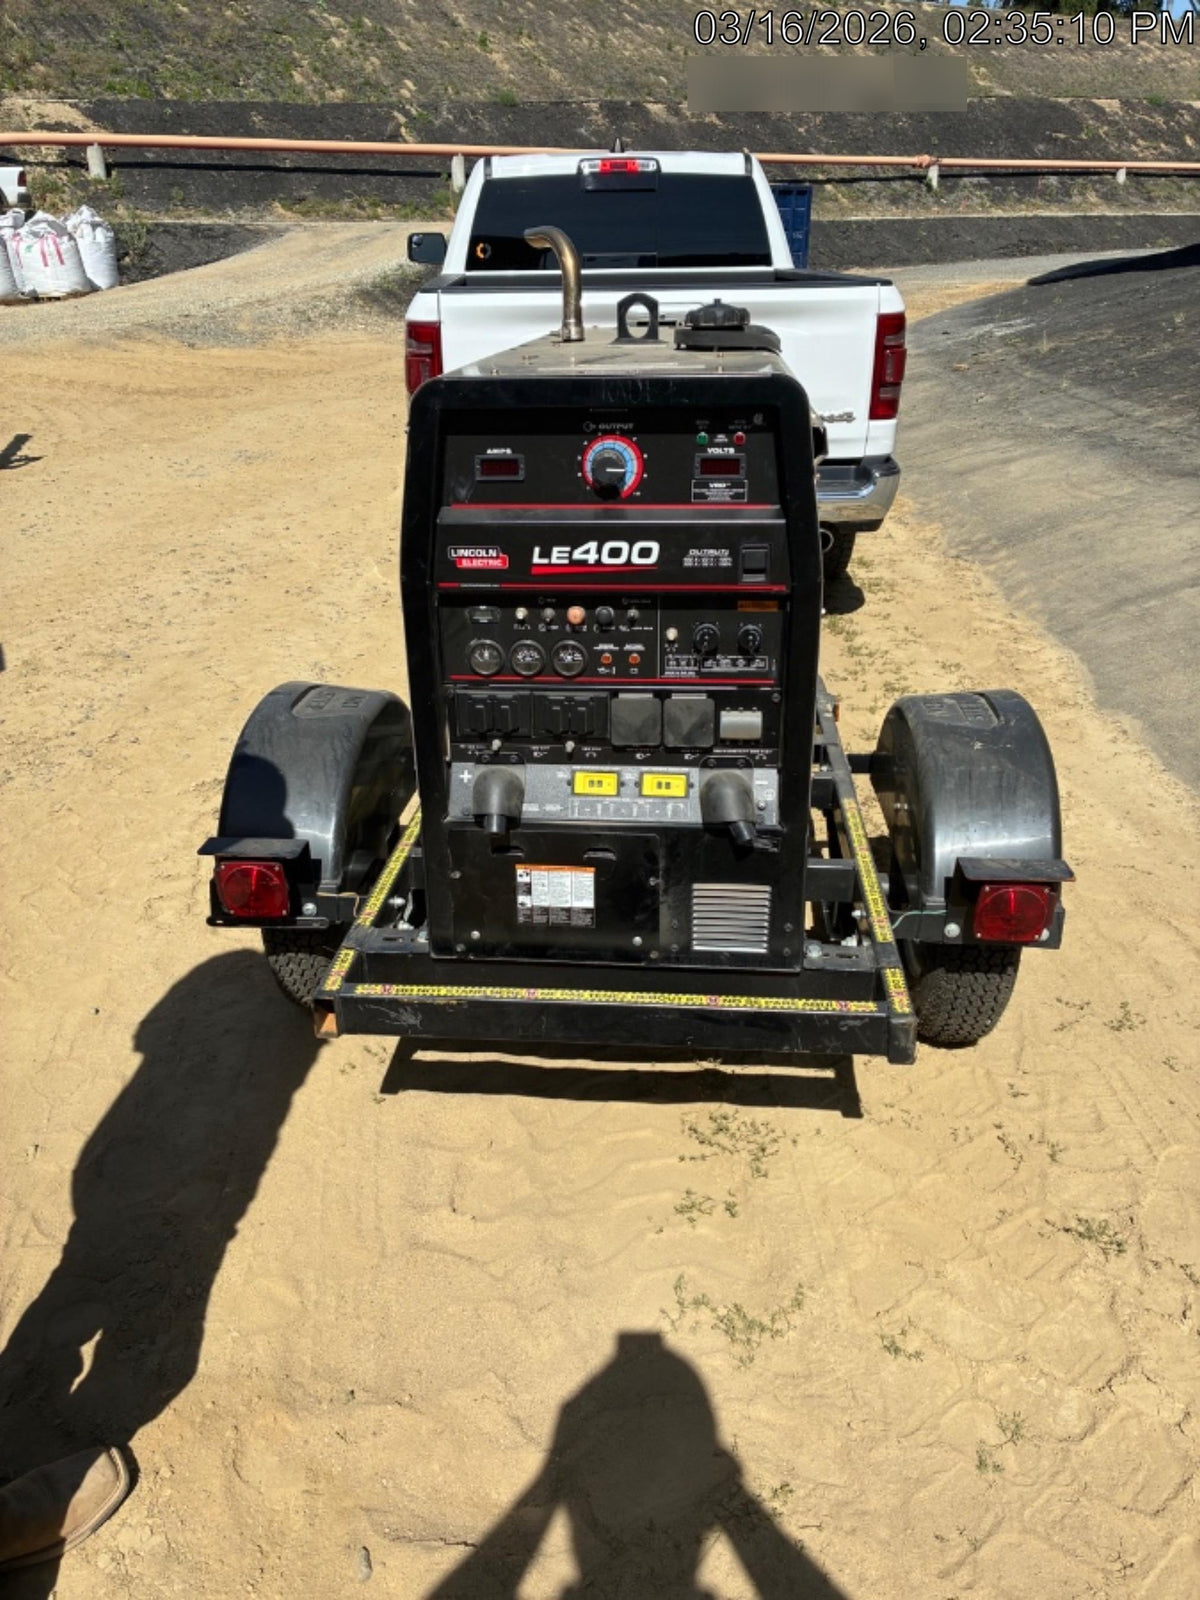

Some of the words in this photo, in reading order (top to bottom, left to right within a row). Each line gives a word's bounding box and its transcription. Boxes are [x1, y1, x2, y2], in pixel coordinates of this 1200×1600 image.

[450, 548, 498, 558] LINCOLN
[532, 540, 660, 565] LE400
[461, 558, 503, 567] ELECTRIC
